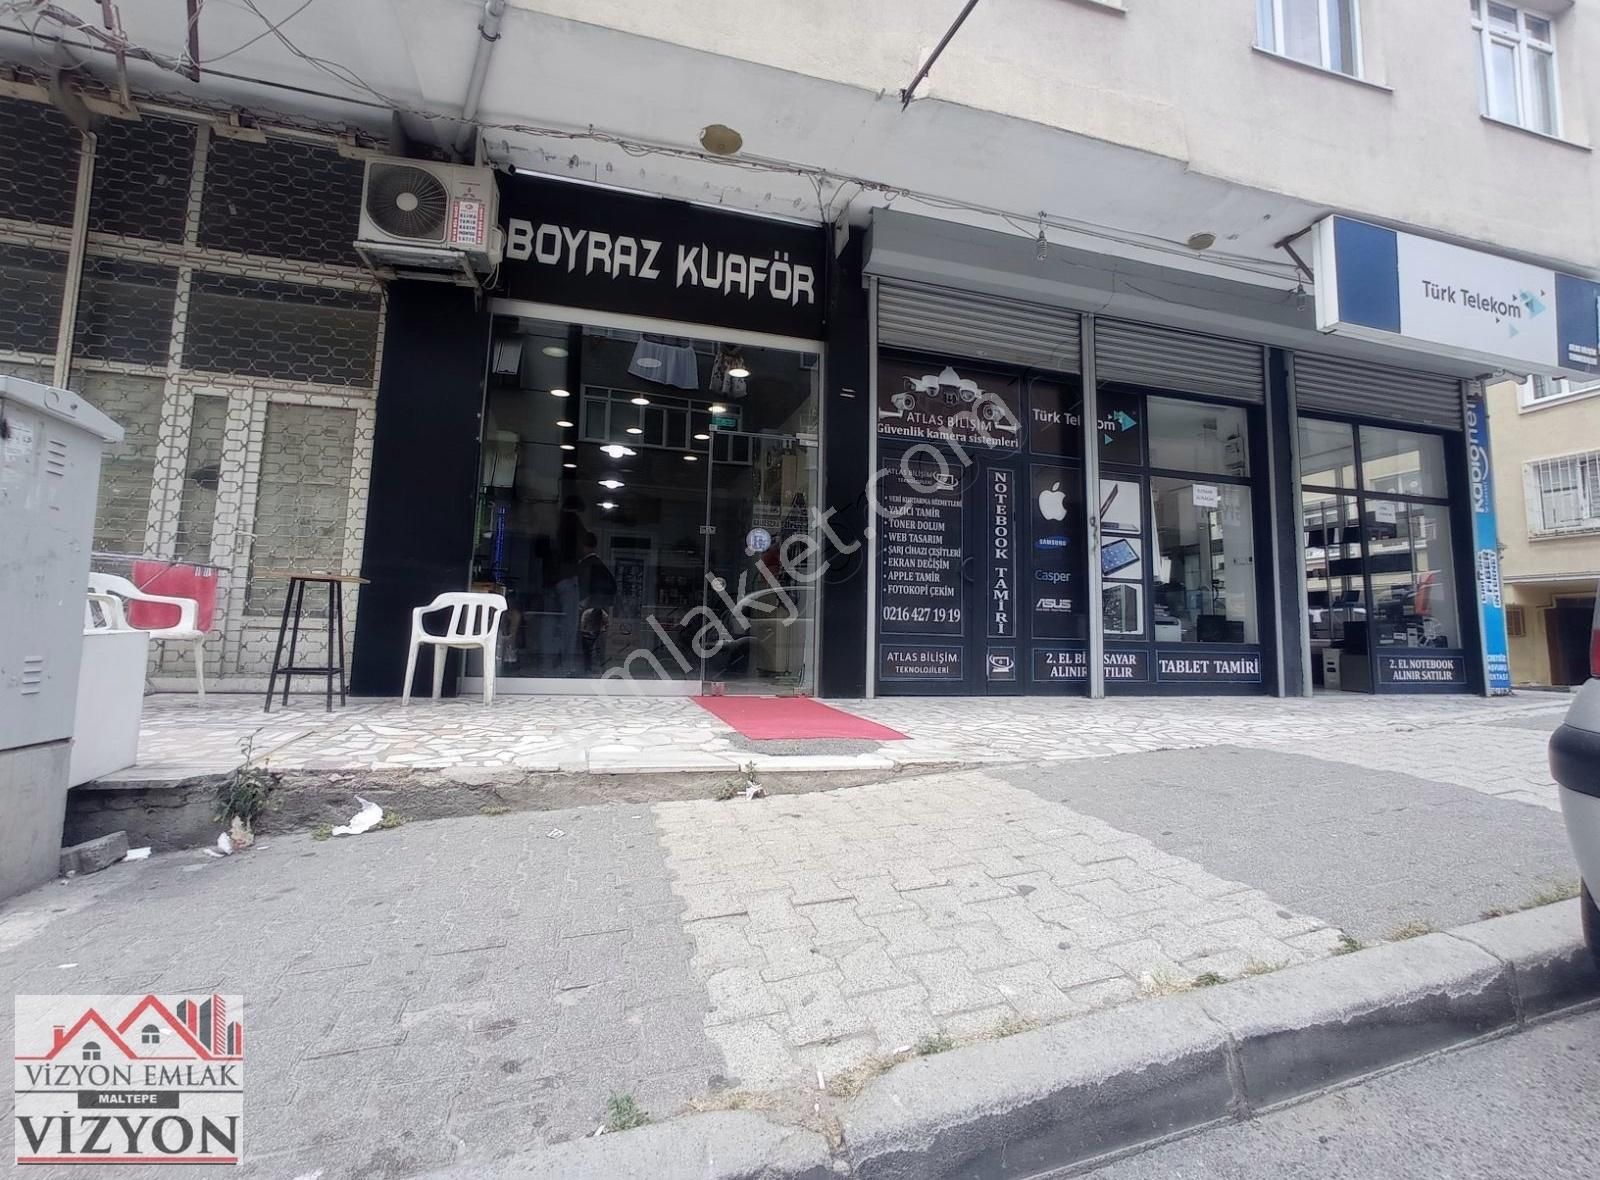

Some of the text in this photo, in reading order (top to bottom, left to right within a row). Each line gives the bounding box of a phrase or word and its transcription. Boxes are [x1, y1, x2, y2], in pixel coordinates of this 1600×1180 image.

[507, 218, 662, 280] BOYRAZ
[676, 242, 815, 307] KUAFÖR
[1422, 280, 1521, 318] Türk Telekom
[907, 411, 992, 432] ATLAS BİLİŞİM
[1032, 408, 1061, 424] Türk
[877, 422, 1019, 448] Güvenlik kamera sistemleri
[889, 504, 940, 518] YAZICI TAMİR
[994, 472, 1008, 559] NOTEBOOK
[889, 519, 945, 531] TONER DOLUM
[888, 532, 943, 545] WEB TASARIM
[1039, 538, 1067, 546] SAMSUNG
[888, 545, 904, 555] ŞARJ
[905, 544, 927, 555] CİHAZI
[888, 557, 950, 571] EKRAN DEĞİŞİM
[888, 571, 940, 582] APPLE TAMİR
[1035, 569, 1071, 584] Casper
[888, 584, 955, 597] FOTOKOPİ ÇEKİM
[993, 567, 1009, 633] TAMİRİ
[1036, 598, 1072, 609] ASUS
[883, 606, 961, 622] 0216 427 19 19
[887, 651, 957, 664] ATLAS BİLİŞİM
[1046, 652, 1056, 664] 2.
[1058, 653, 1072, 664] EL
[1389, 659, 1454, 669] 2. EL NOTEBOOK
[896, 665, 949, 674] TEKNOLOJİLERİ
[1159, 658, 1259, 675] TABLET TAMİRİ
[1393, 670, 1453, 681] ALINIR SATILIR
